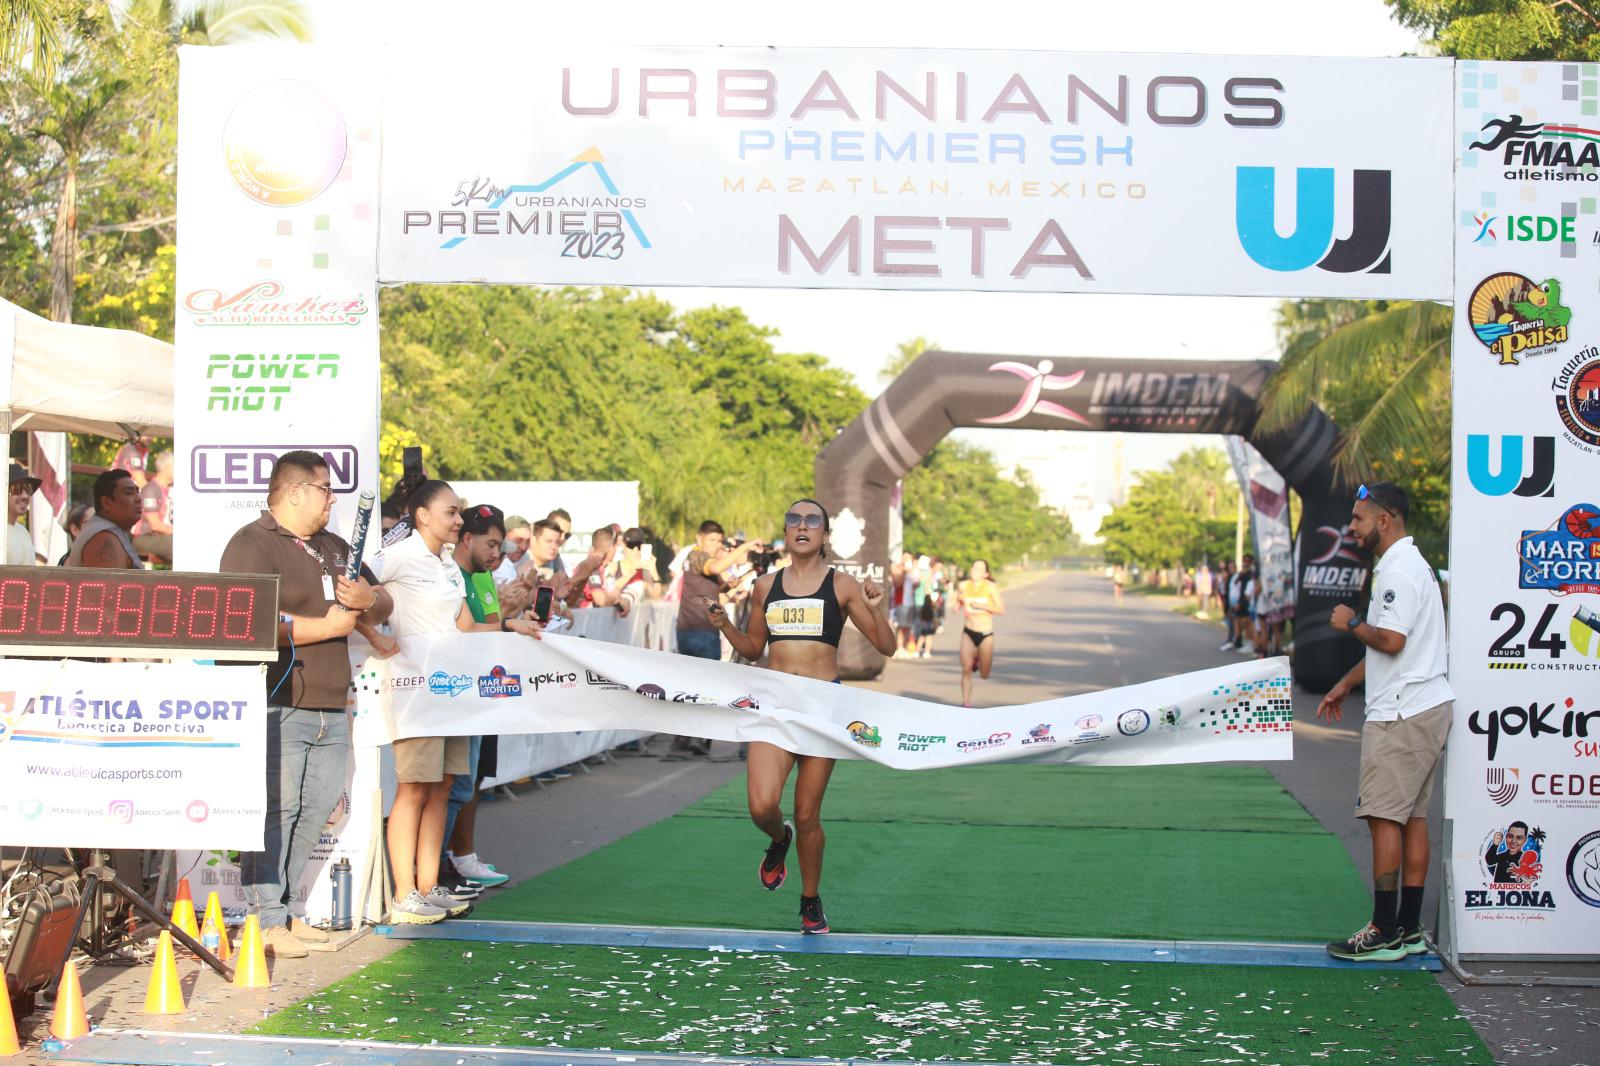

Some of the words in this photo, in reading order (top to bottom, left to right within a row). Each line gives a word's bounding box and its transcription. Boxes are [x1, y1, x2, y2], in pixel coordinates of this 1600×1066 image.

[561, 67, 1286, 128] URBANIANOS
[738, 130, 1027, 165] PREMIER
[1503, 169, 1600, 183] atletismo
[515, 196, 648, 209] URBANIANOS
[402, 210, 624, 236] PREMIER
[1507, 215, 1576, 243] ISDE
[560, 230, 626, 260] 2023
[777, 213, 1096, 281] META
[206, 353, 341, 379] POWER
[1090, 372, 1230, 406] IMDEM
[198, 452, 351, 485] LEDN
[1525, 540, 1586, 560] MAR
[1303, 565, 1367, 587] IMDEM
[783, 608, 805, 623] 033
[1488, 602, 1567, 659] 24
[1531, 663, 1600, 672] CONSTRUCT
[390, 676, 425, 687] CEDEP
[484, 685, 521, 694] TORITO
[158, 699, 248, 721] SPORT
[898, 733, 946, 744] POWER
[1574, 740, 1600, 757] su
[1464, 890, 1493, 908] EL
[1496, 890, 1556, 909] JONA
